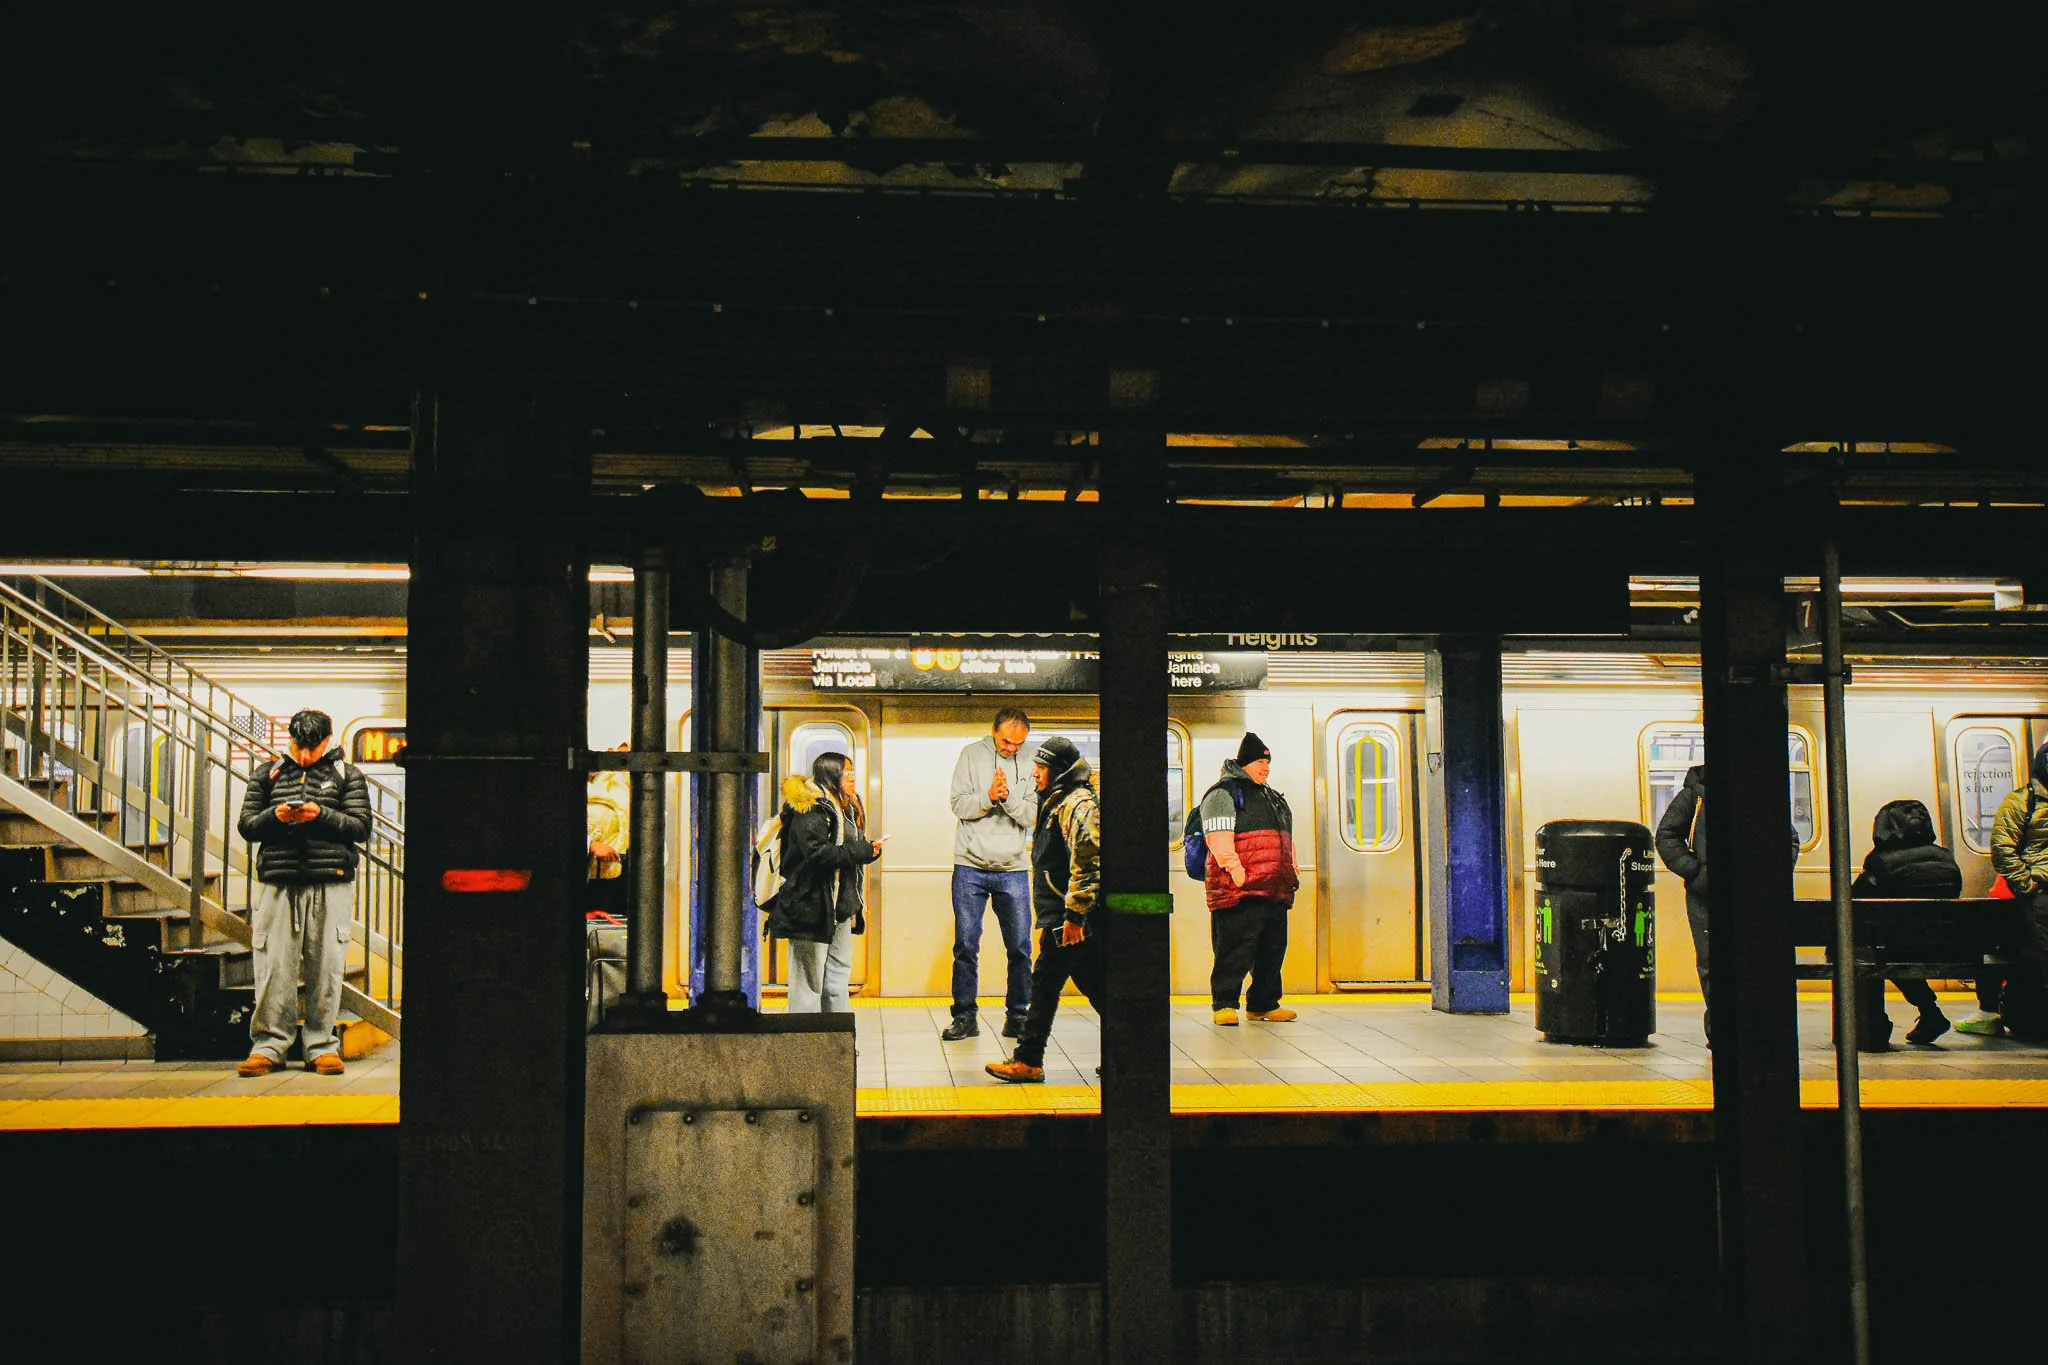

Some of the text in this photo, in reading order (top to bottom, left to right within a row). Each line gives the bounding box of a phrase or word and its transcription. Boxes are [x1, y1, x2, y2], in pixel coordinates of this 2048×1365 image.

[1801, 601, 1812, 628] 7
[812, 658, 870, 674] Jamaica
[1168, 661, 1220, 674] Jamaica
[812, 672, 877, 688] via Local
[1171, 675, 1202, 688] here
